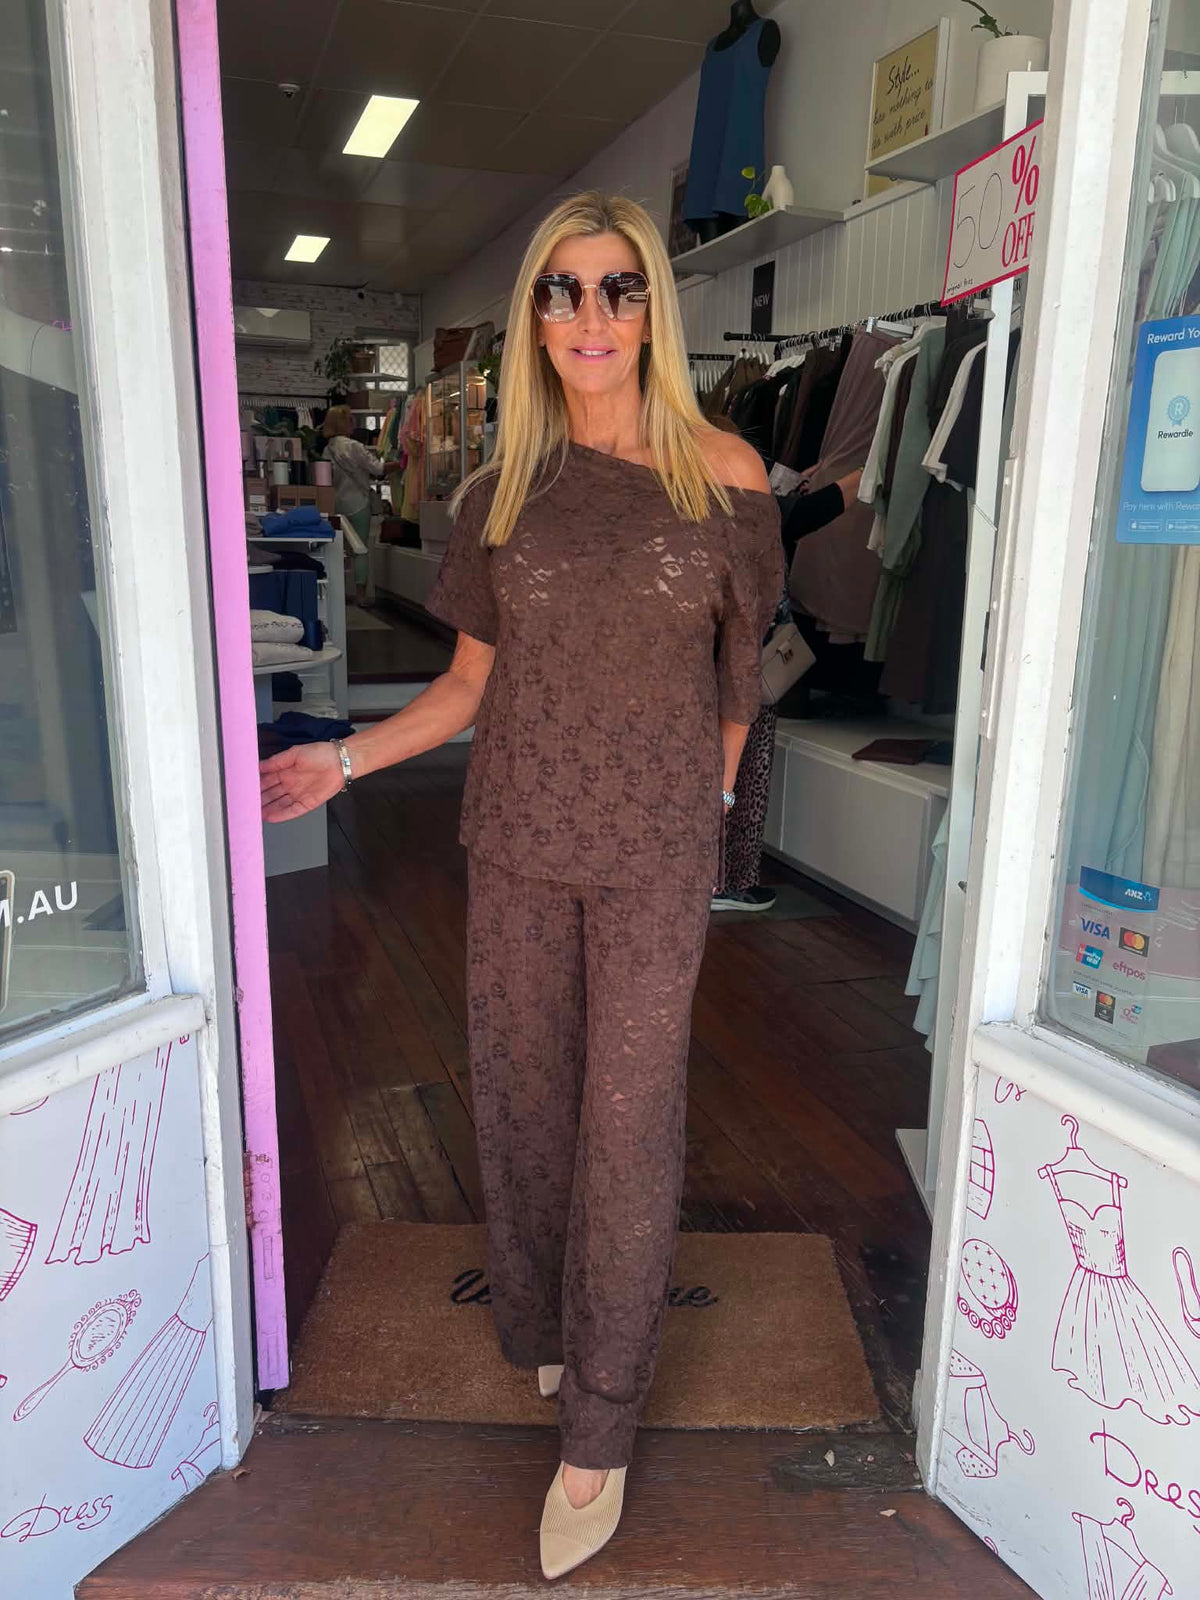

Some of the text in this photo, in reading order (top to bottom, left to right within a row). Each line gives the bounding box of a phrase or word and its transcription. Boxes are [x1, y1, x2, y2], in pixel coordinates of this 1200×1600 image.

[1001, 211, 1036, 268] OFF
[753, 293, 770, 309] NEW
[1147, 328, 1186, 345] Reward
[1124, 888, 1144, 901] ANZ
[1080, 917, 1111, 940] VISA
[1112, 961, 1147, 981] eftpos
[1075, 985, 1089, 996] VISA
[0, 1493, 113, 1542] Dress
